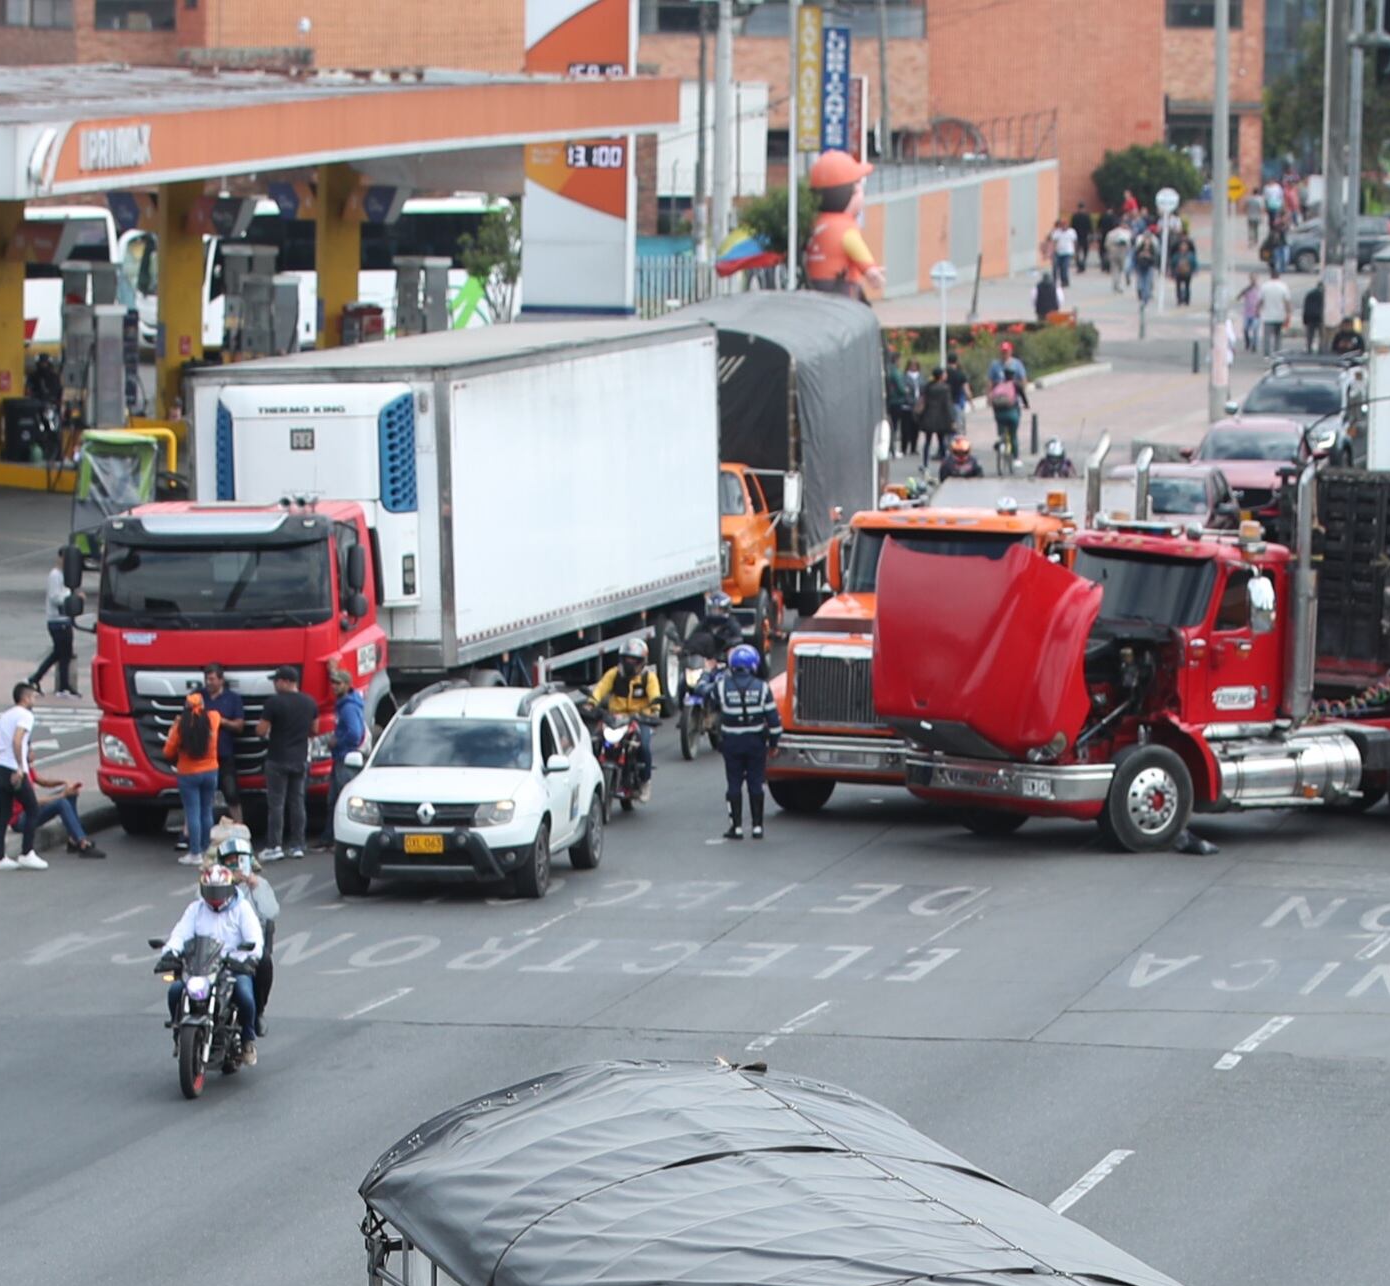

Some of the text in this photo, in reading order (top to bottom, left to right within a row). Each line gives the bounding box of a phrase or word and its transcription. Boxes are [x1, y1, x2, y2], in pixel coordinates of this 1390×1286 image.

[825, 29, 846, 147] LUBRICANTES
[81, 124, 152, 170] PRIMAX
[257, 406, 310, 414] THERMO
